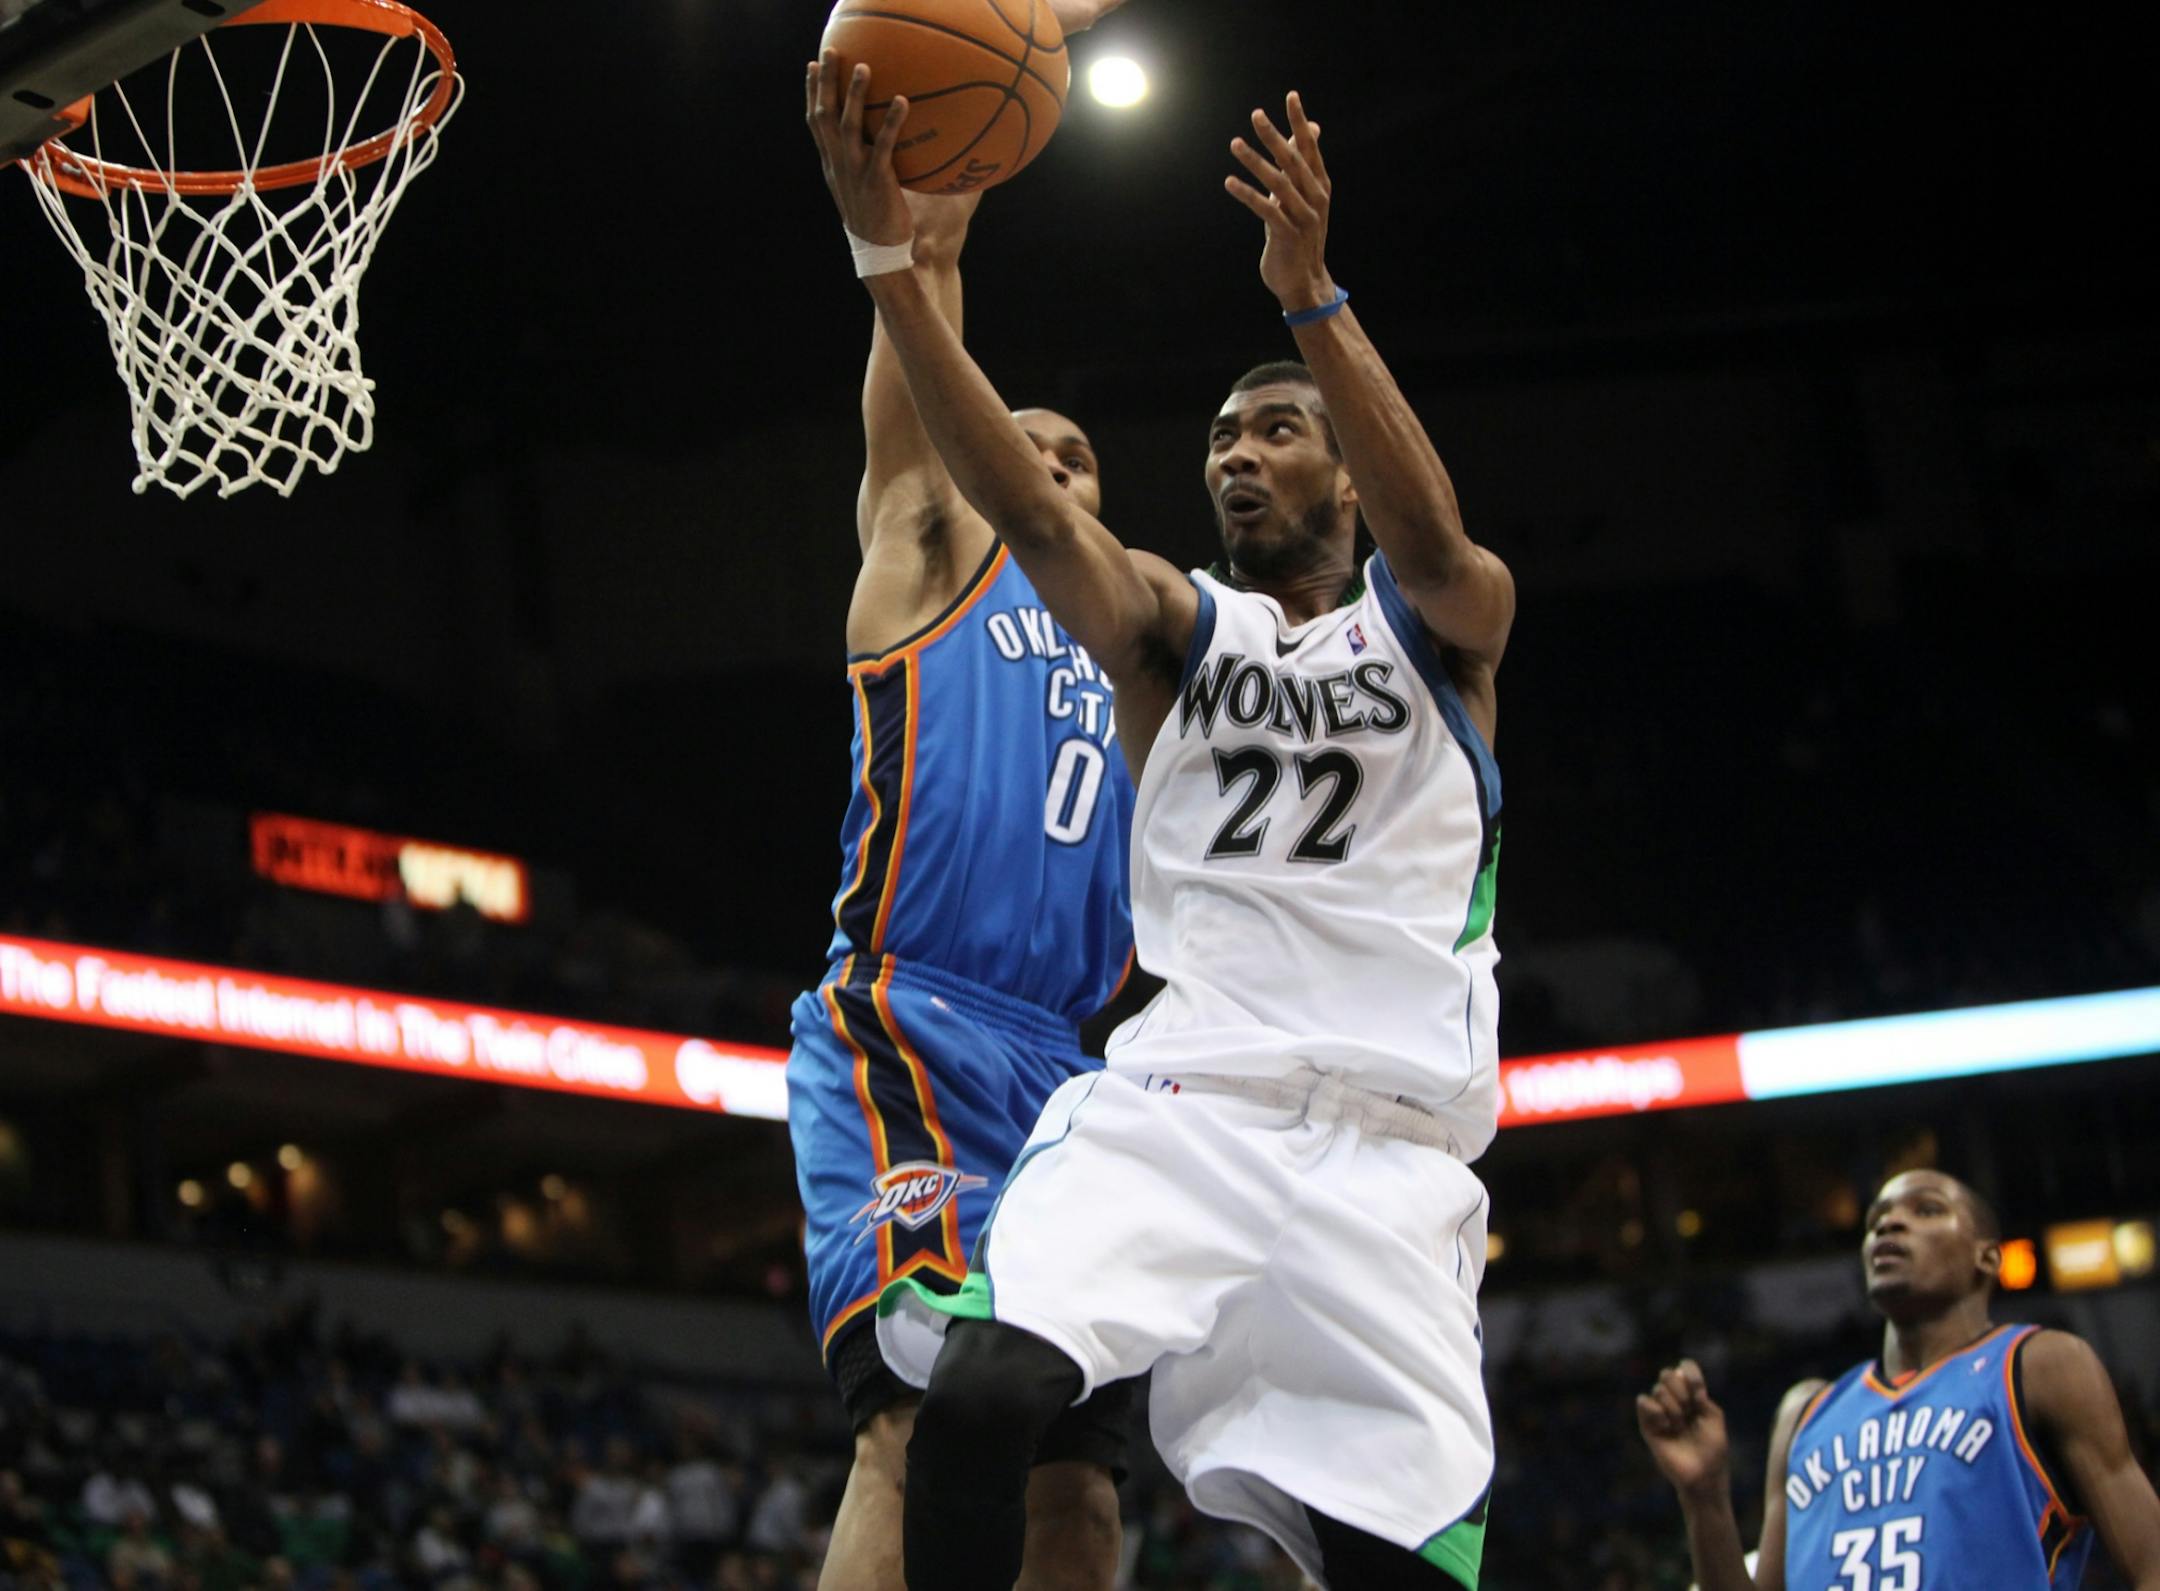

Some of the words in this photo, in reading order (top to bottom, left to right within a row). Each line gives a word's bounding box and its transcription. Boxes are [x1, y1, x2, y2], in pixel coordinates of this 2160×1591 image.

[1178, 653, 1411, 743] WOLVES
[1043, 736, 1106, 846] 0
[1205, 745, 1364, 864] 22
[1785, 1405, 1994, 1511] OKLAHOMA
[1842, 1454, 1926, 1513] CITY
[1827, 1515, 1924, 1591] 35
